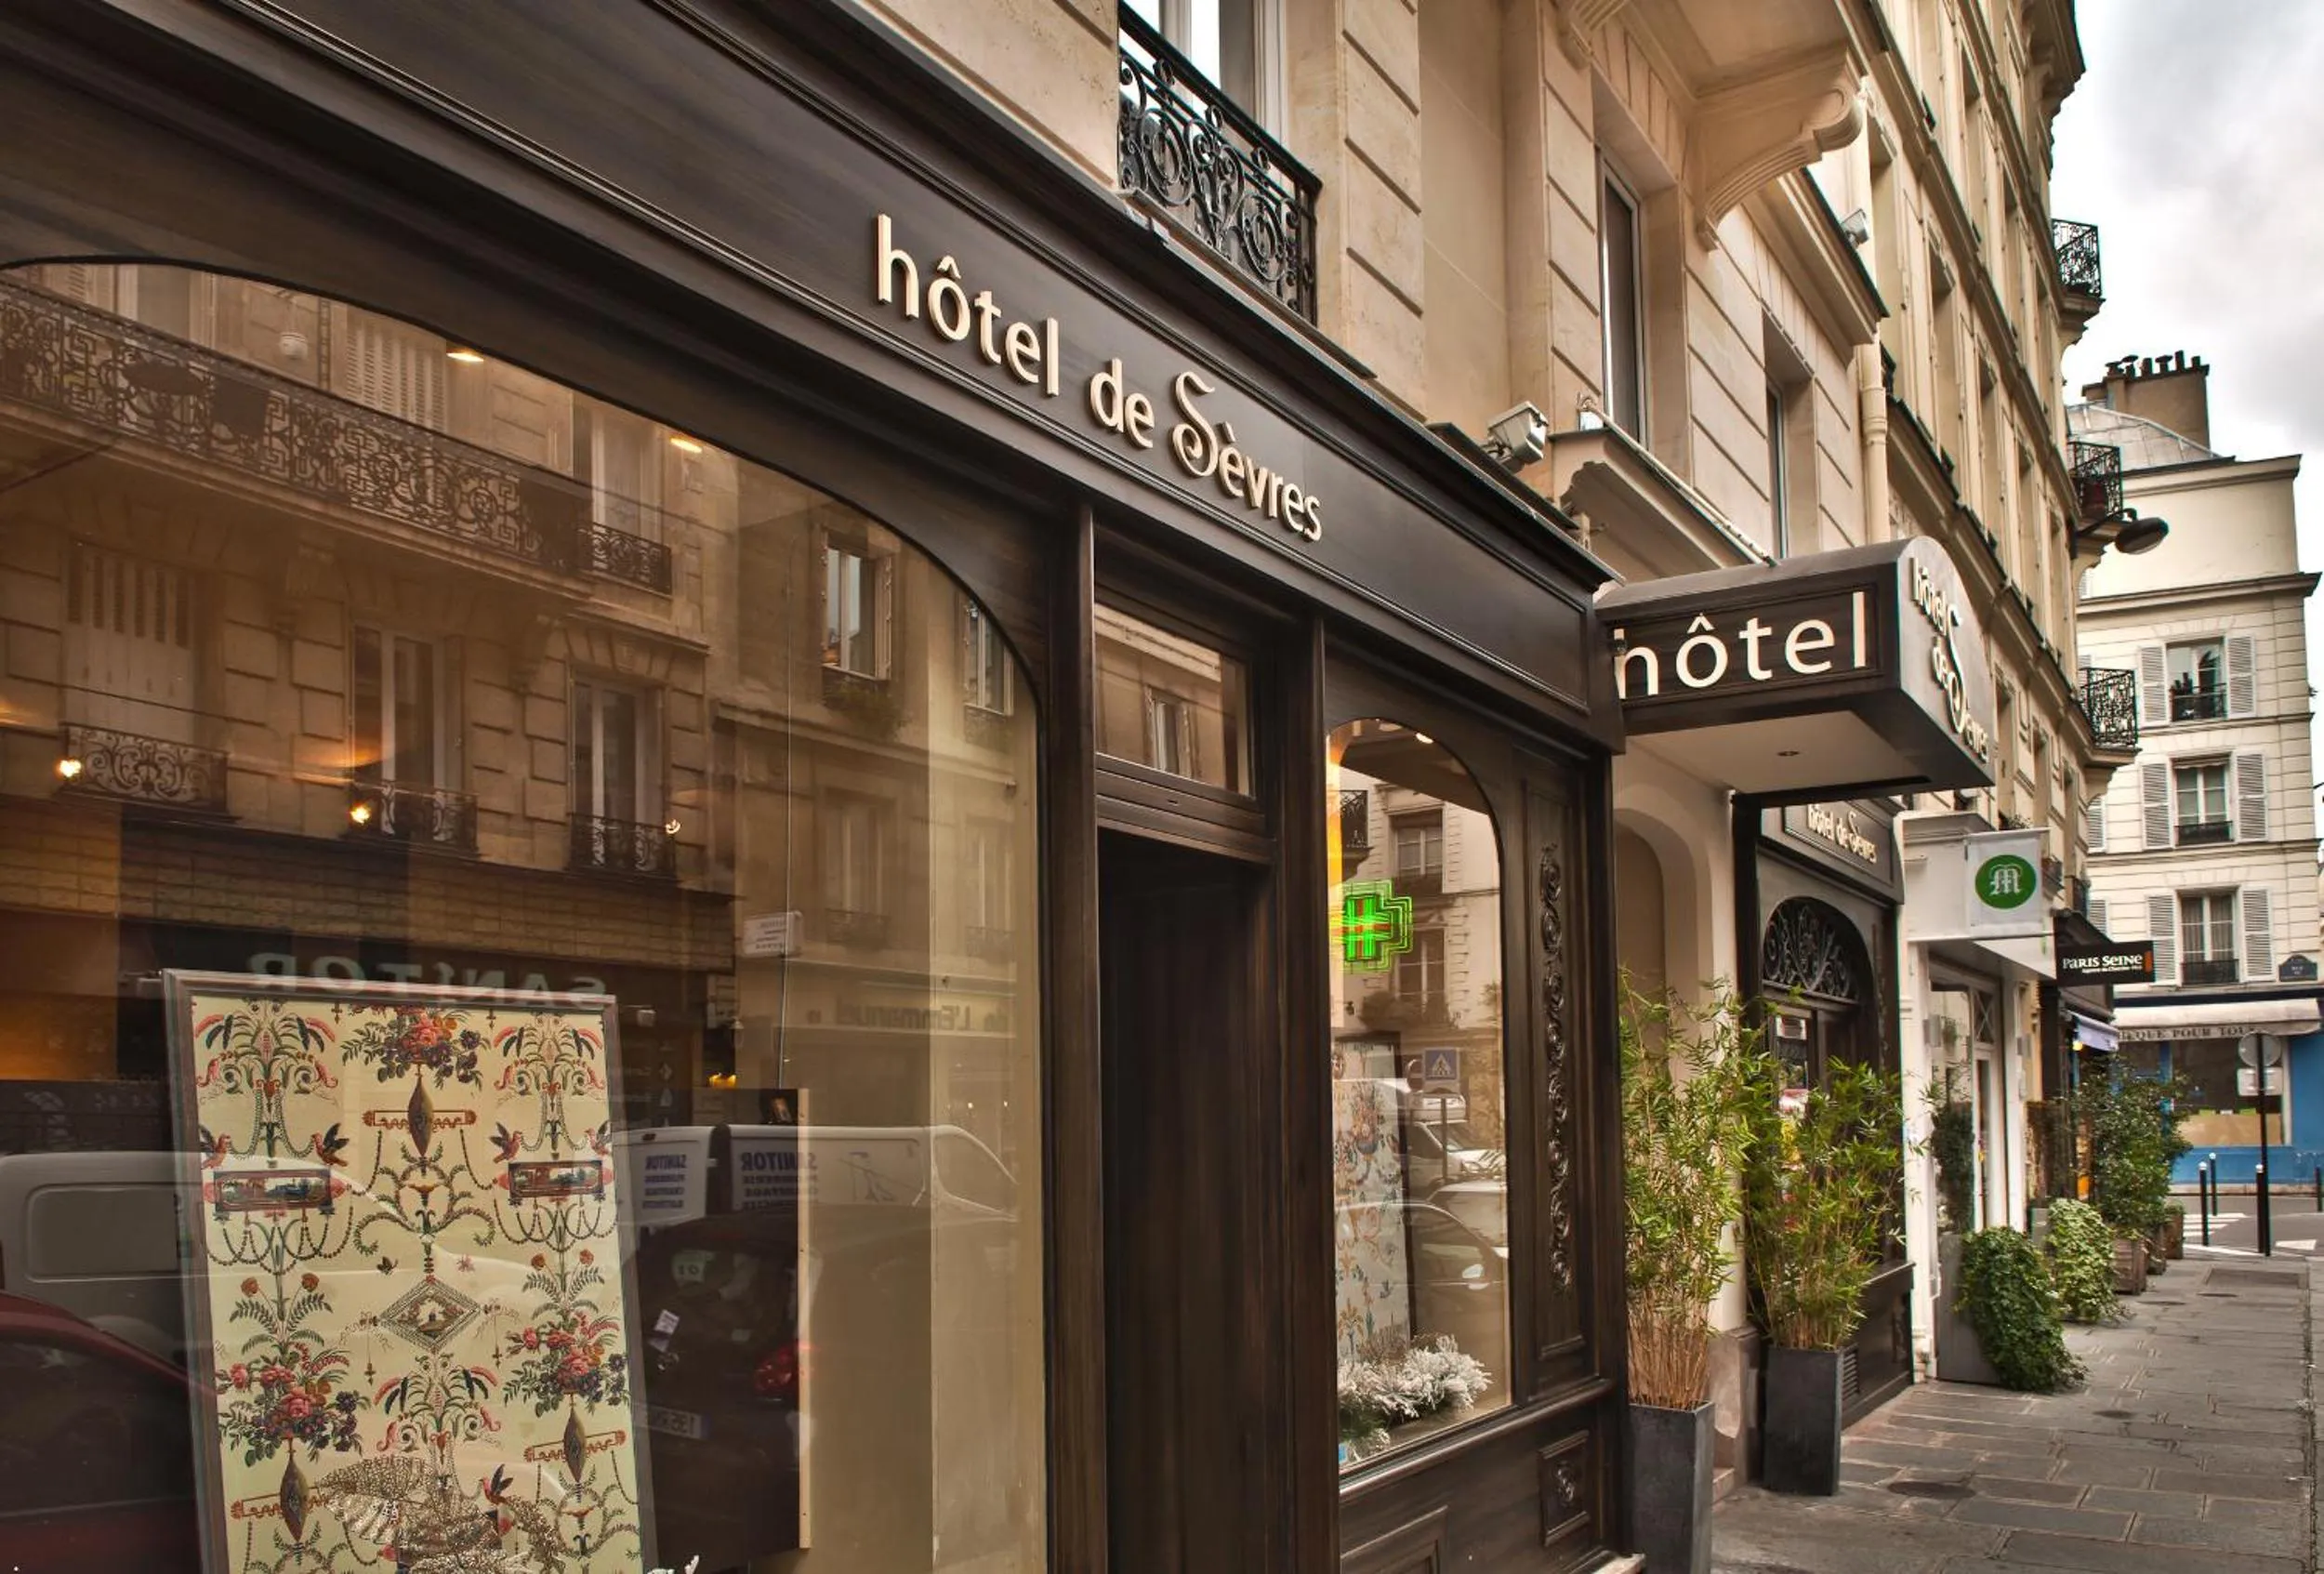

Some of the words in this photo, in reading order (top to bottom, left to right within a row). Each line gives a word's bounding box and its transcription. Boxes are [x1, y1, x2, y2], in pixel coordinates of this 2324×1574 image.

[877, 213, 1060, 397] hôtel
[1089, 357, 1155, 449] de
[1172, 371, 1323, 542] Sèvres
[1614, 591, 1867, 699] hôtel
[1911, 558, 1947, 637] hôtel
[1932, 636, 1950, 689] de
[1946, 604, 1988, 763] Sèvres
[2172, 1025, 2211, 1038] POUR
